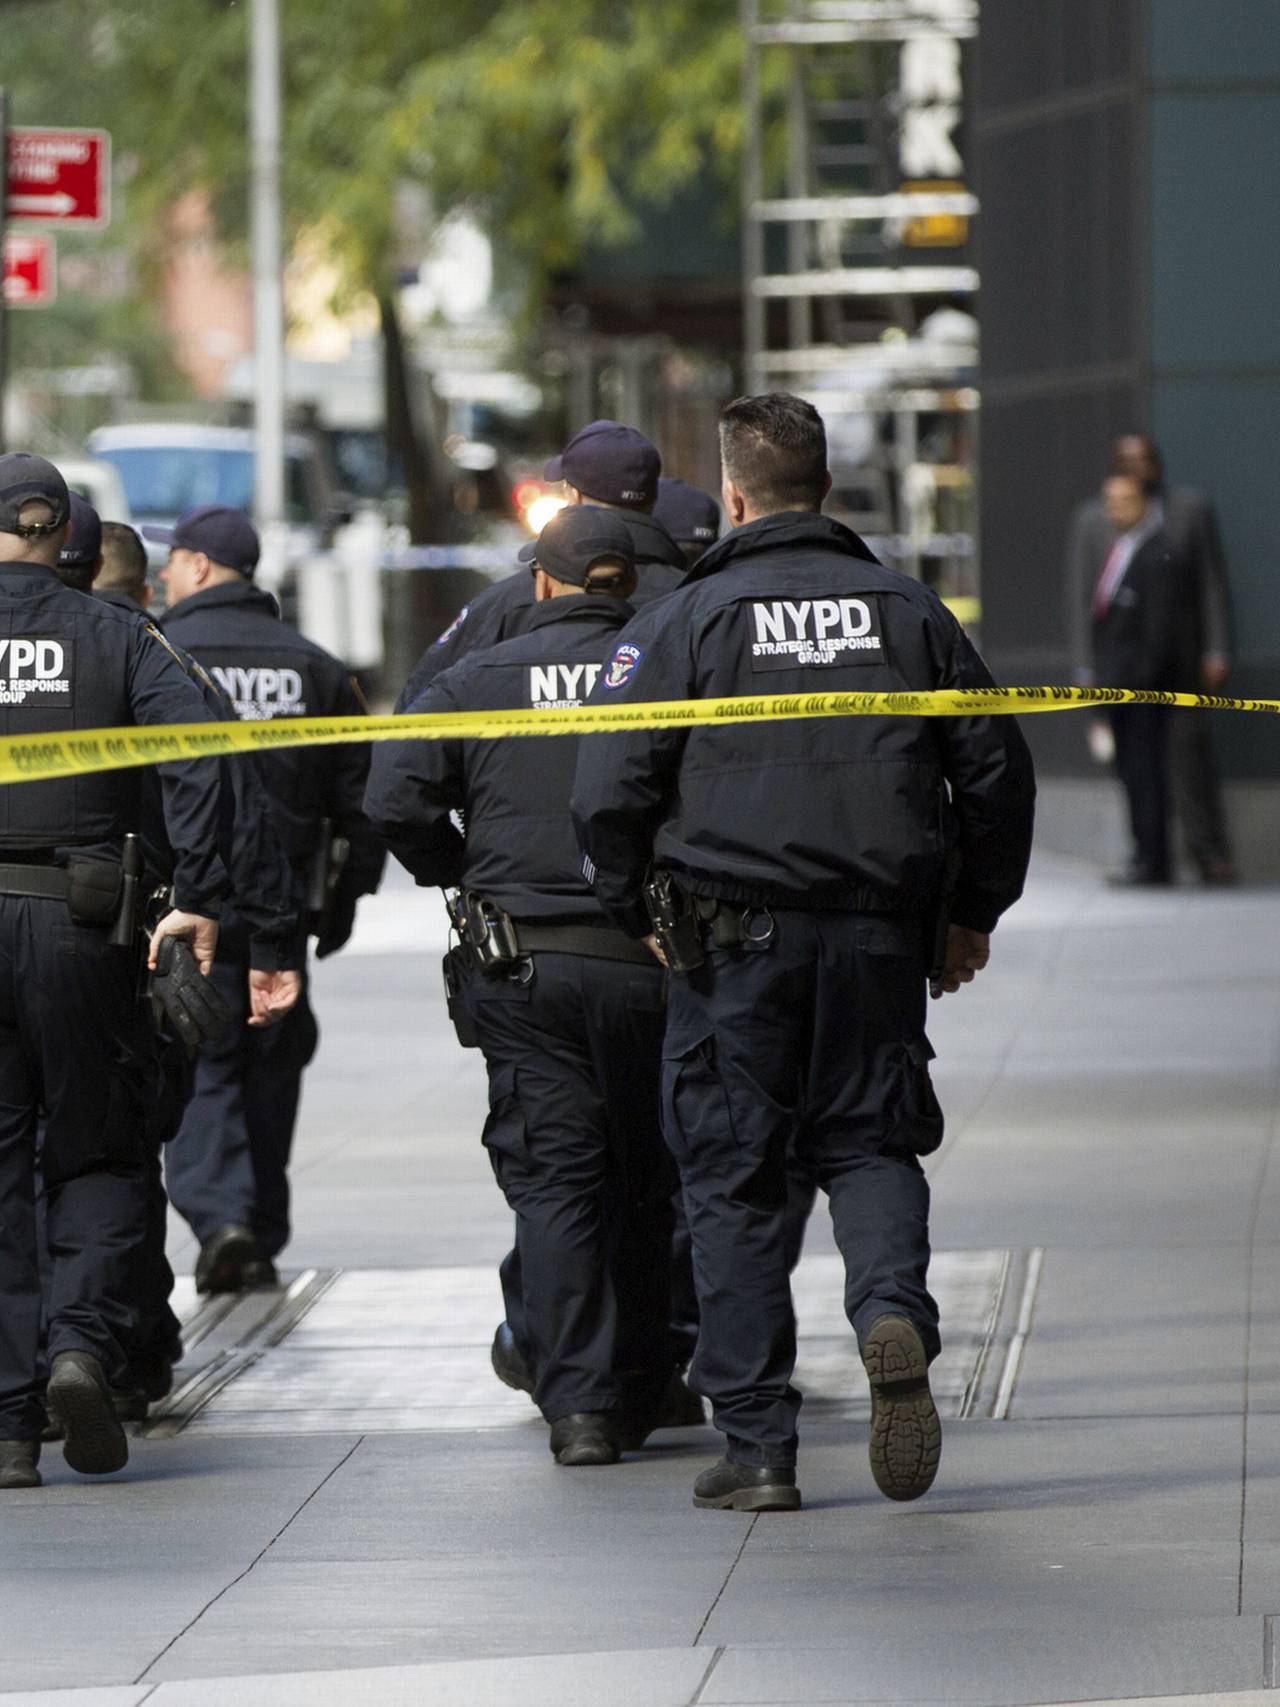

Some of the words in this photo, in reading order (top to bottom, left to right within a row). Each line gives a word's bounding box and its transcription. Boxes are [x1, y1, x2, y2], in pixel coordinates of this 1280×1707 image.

[753, 599, 872, 642] NYPD
[752, 640, 815, 656] STRATEGIC
[818, 636, 881, 652] RESPONSE
[797, 651, 837, 664] GROUP
[9, 679, 70, 693] RESPONSE
